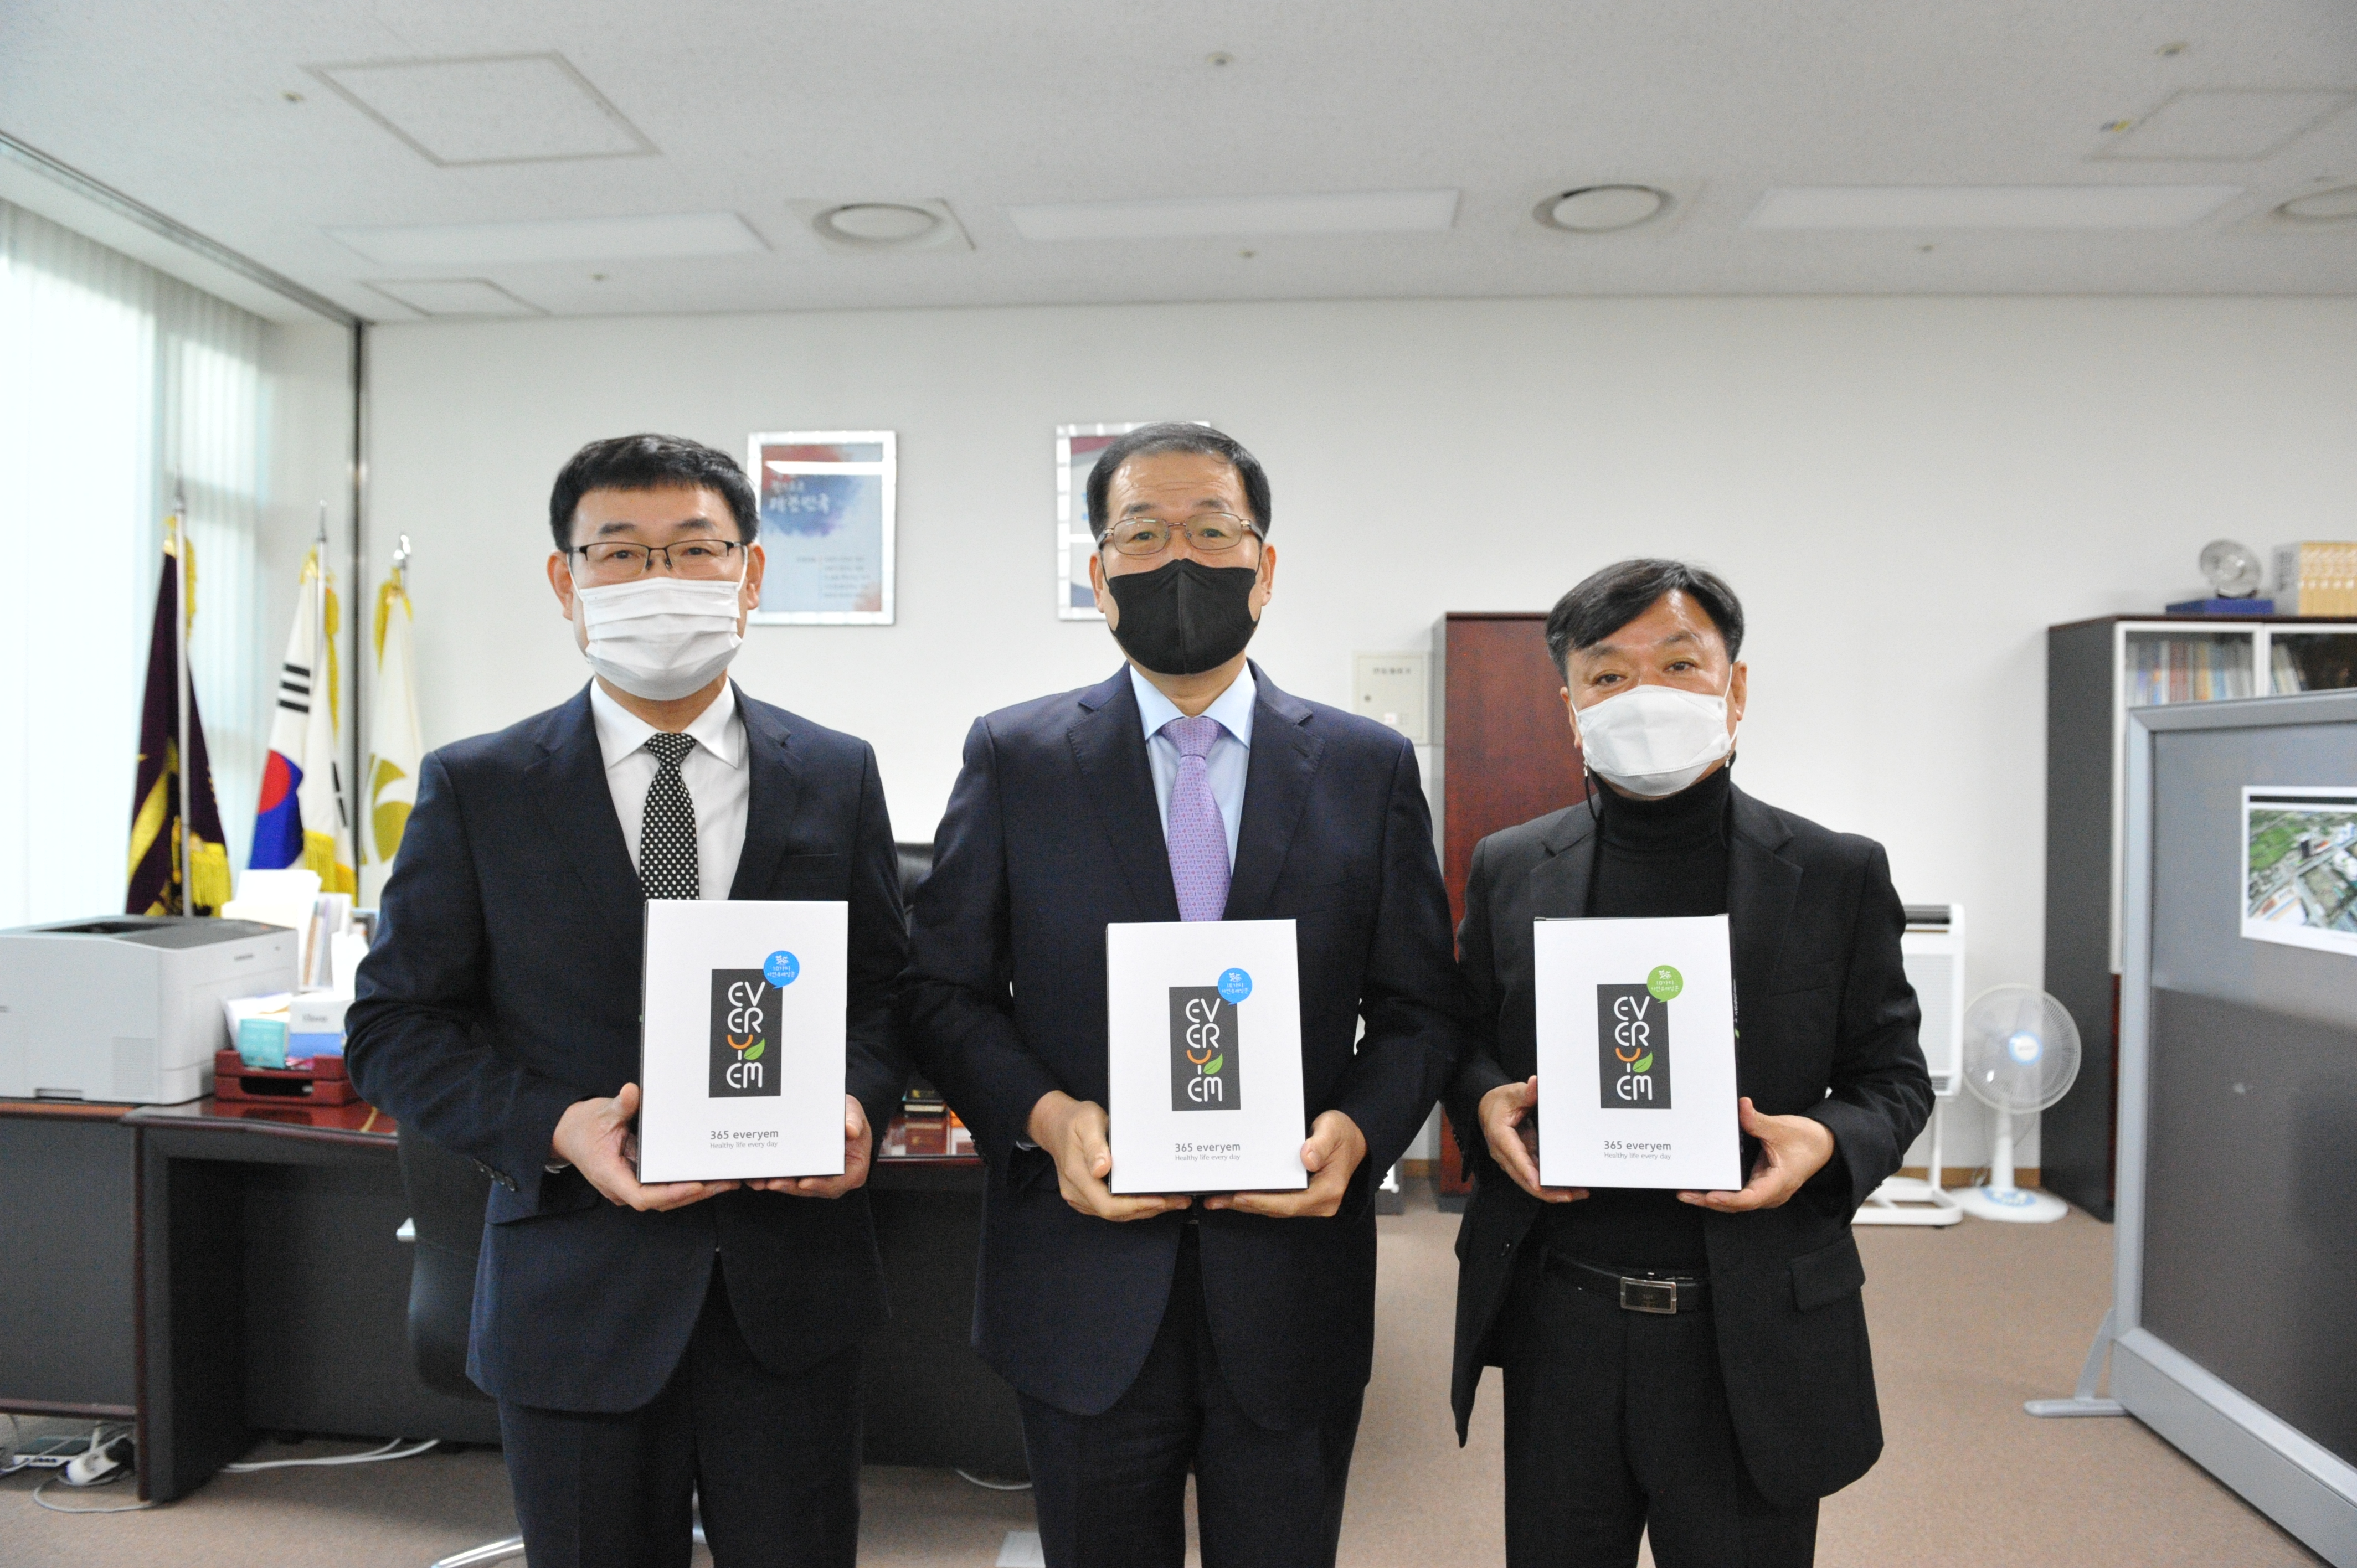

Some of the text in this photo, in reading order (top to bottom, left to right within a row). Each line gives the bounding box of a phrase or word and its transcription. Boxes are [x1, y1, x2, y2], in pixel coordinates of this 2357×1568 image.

[710, 1130, 779, 1141] 365 everyem
[1175, 1143, 1241, 1154] 365 everyem
[1604, 1141, 1671, 1152] 365 everyem
[1604, 1152, 1628, 1160] Healthy
